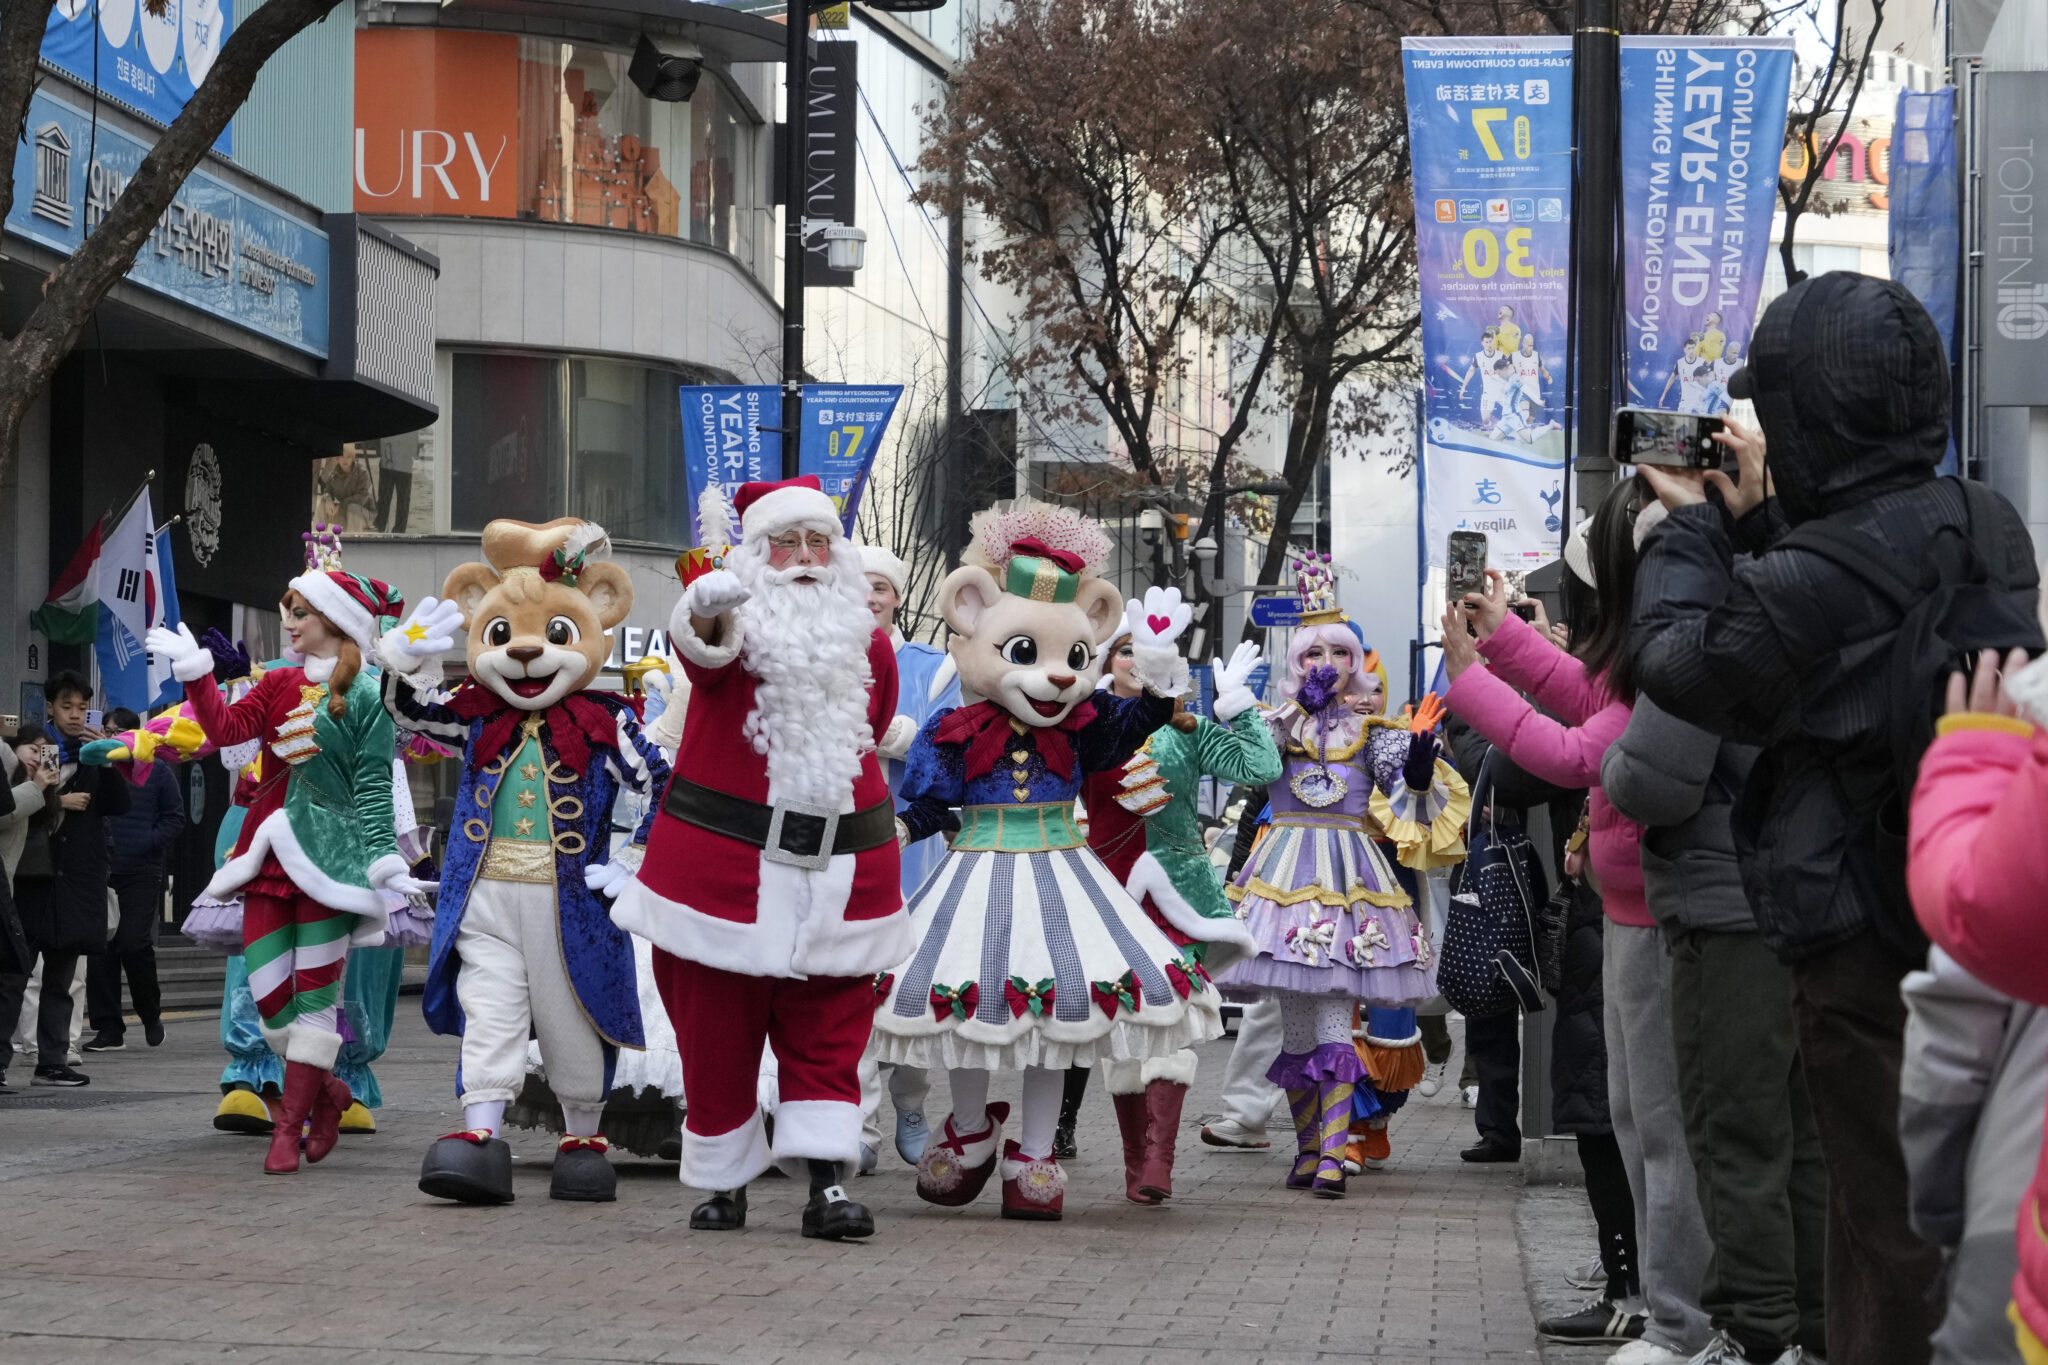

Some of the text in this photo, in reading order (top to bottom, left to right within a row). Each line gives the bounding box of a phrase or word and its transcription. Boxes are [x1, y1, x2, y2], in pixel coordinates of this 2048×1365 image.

[116, 56, 157, 99] 진료 중입니다
[806, 132, 837, 258] LUXUY
[746, 392, 760, 454] SHINING
[842, 425, 865, 458] 7
